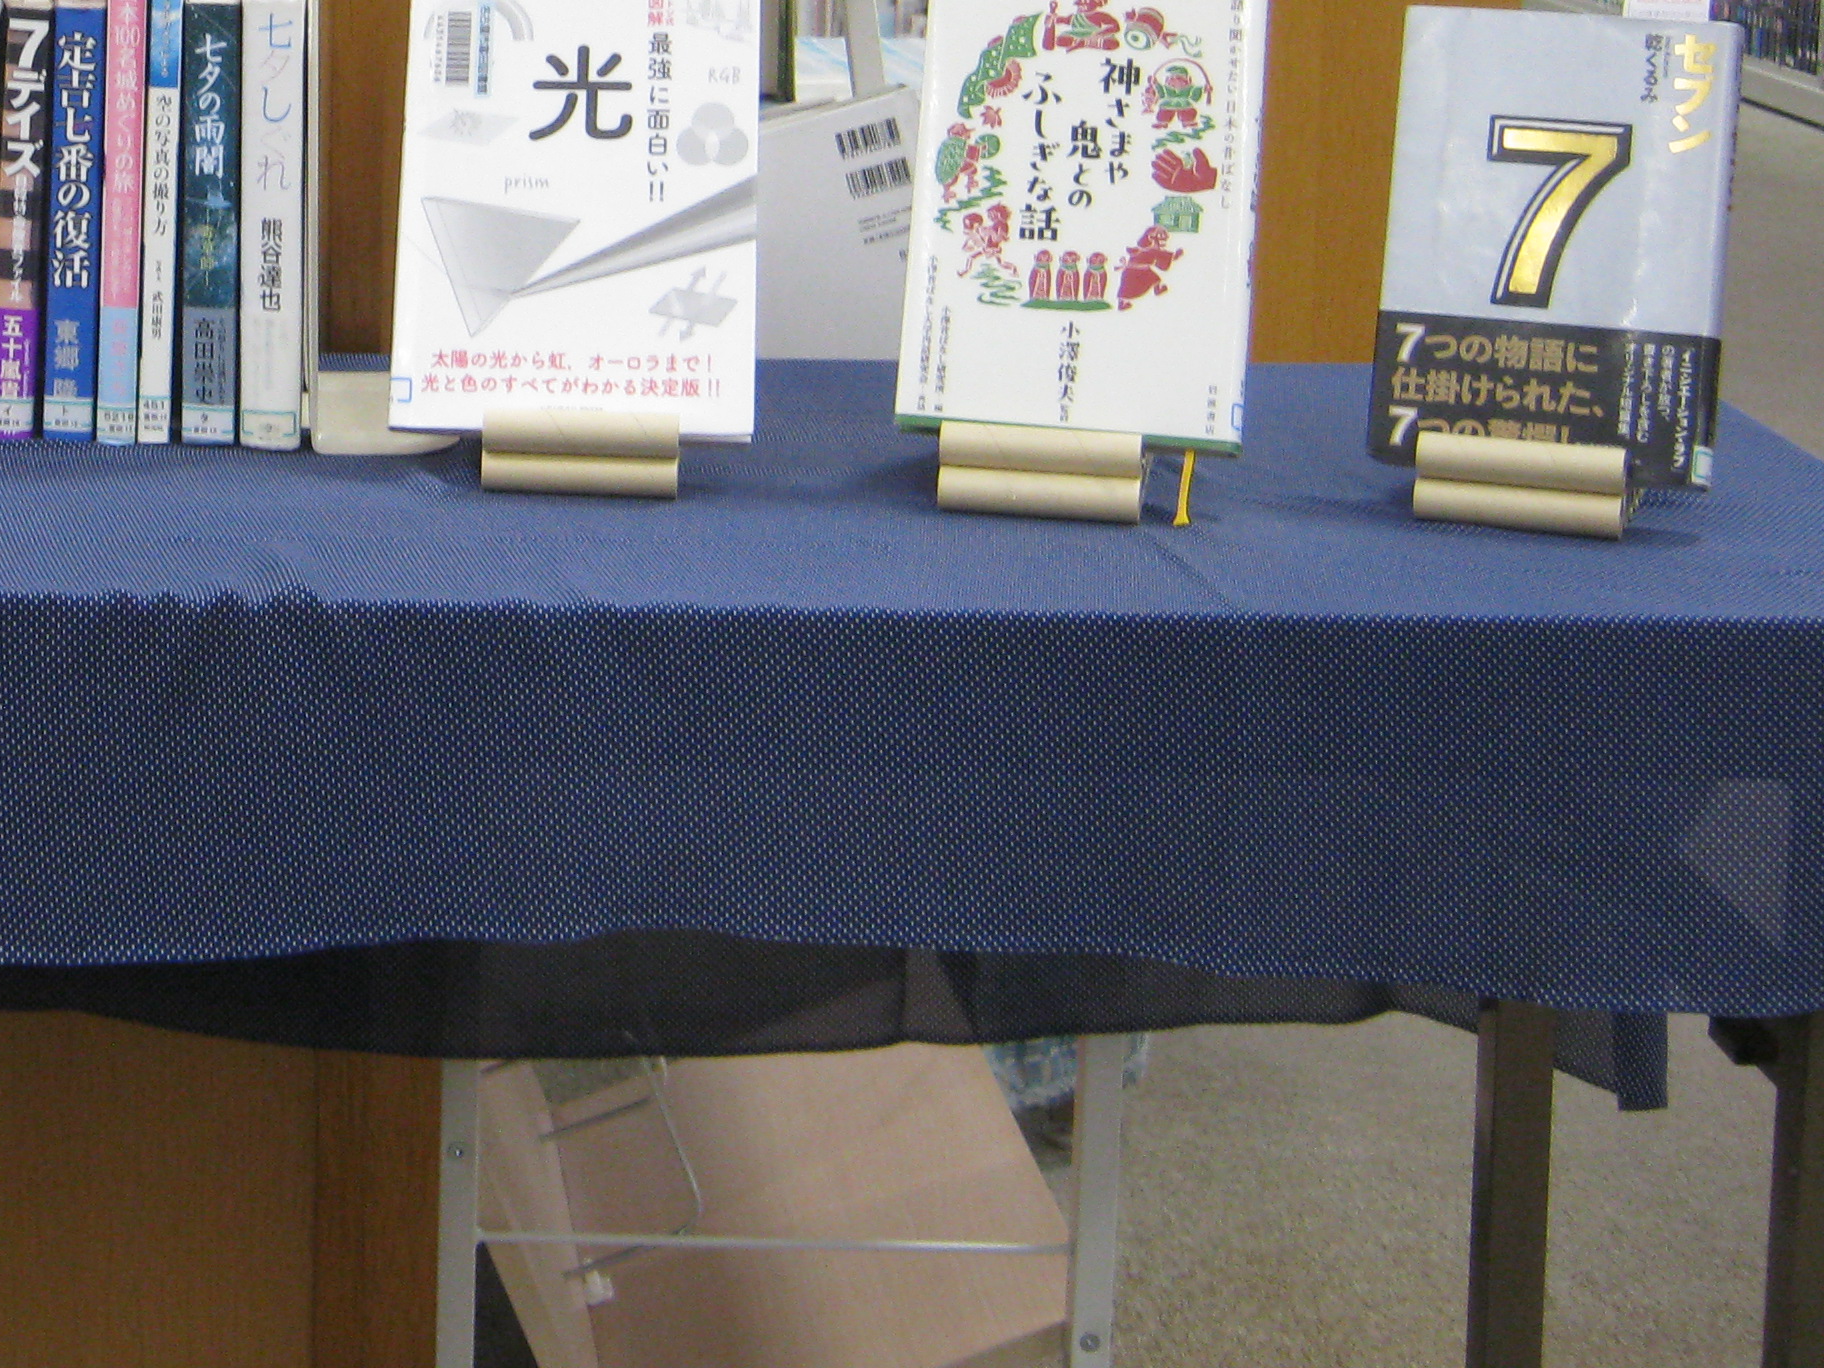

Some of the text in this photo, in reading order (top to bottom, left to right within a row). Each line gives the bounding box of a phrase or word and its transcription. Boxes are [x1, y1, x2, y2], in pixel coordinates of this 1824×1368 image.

[3, 18, 49, 178] 7デイズ
[194, 33, 227, 178] 七夕の雨闇
[256, 12, 294, 191] 七夕しぐれ
[529, 44, 633, 142] 光
[708, 66, 742, 84] RGB
[1640, 33, 1664, 104] 乾くるみ
[1668, 33, 1718, 154] セブン
[52, 31, 97, 289] 定吉七番の復活
[152, 94, 173, 237] 空の写真の撮り方
[1019, 70, 1062, 242] ふしぎな話
[1067, 120, 1102, 209] 鬼との
[1100, 57, 1141, 185] 神さまや
[503, 174, 551, 194] prism
[1486, 113, 1634, 310] 7
[260, 217, 284, 312] 熊谷達也
[194, 318, 215, 404] 高田崇史
[1058, 320, 1081, 403] 小澤俊夫
[1391, 366, 1605, 418] 仕掛けられた、
[1395, 322, 1599, 374] 7つの物語に
